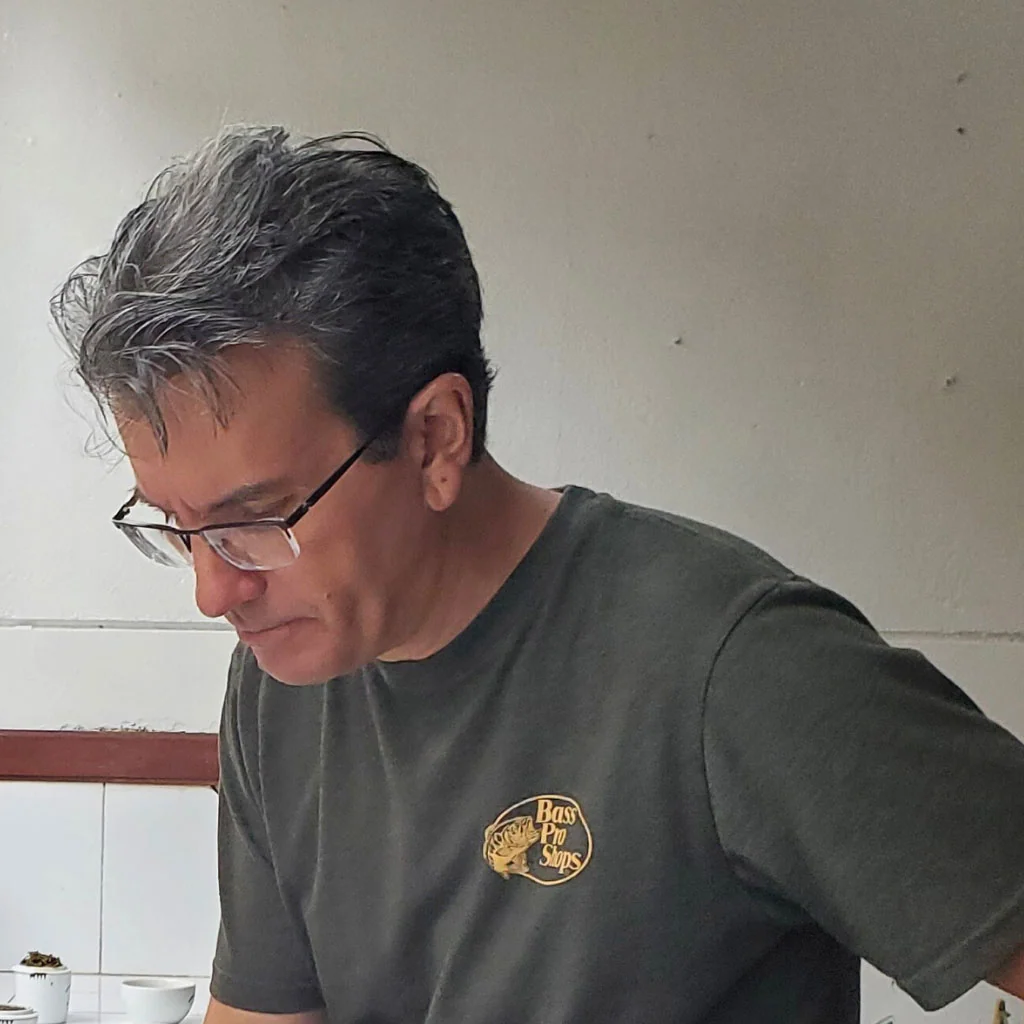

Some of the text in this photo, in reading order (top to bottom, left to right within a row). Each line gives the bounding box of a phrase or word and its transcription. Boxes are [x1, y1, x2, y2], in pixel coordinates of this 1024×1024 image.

[536, 799, 577, 825] Bass
[540, 822, 567, 845] Pro
[539, 844, 582, 874] Shops
